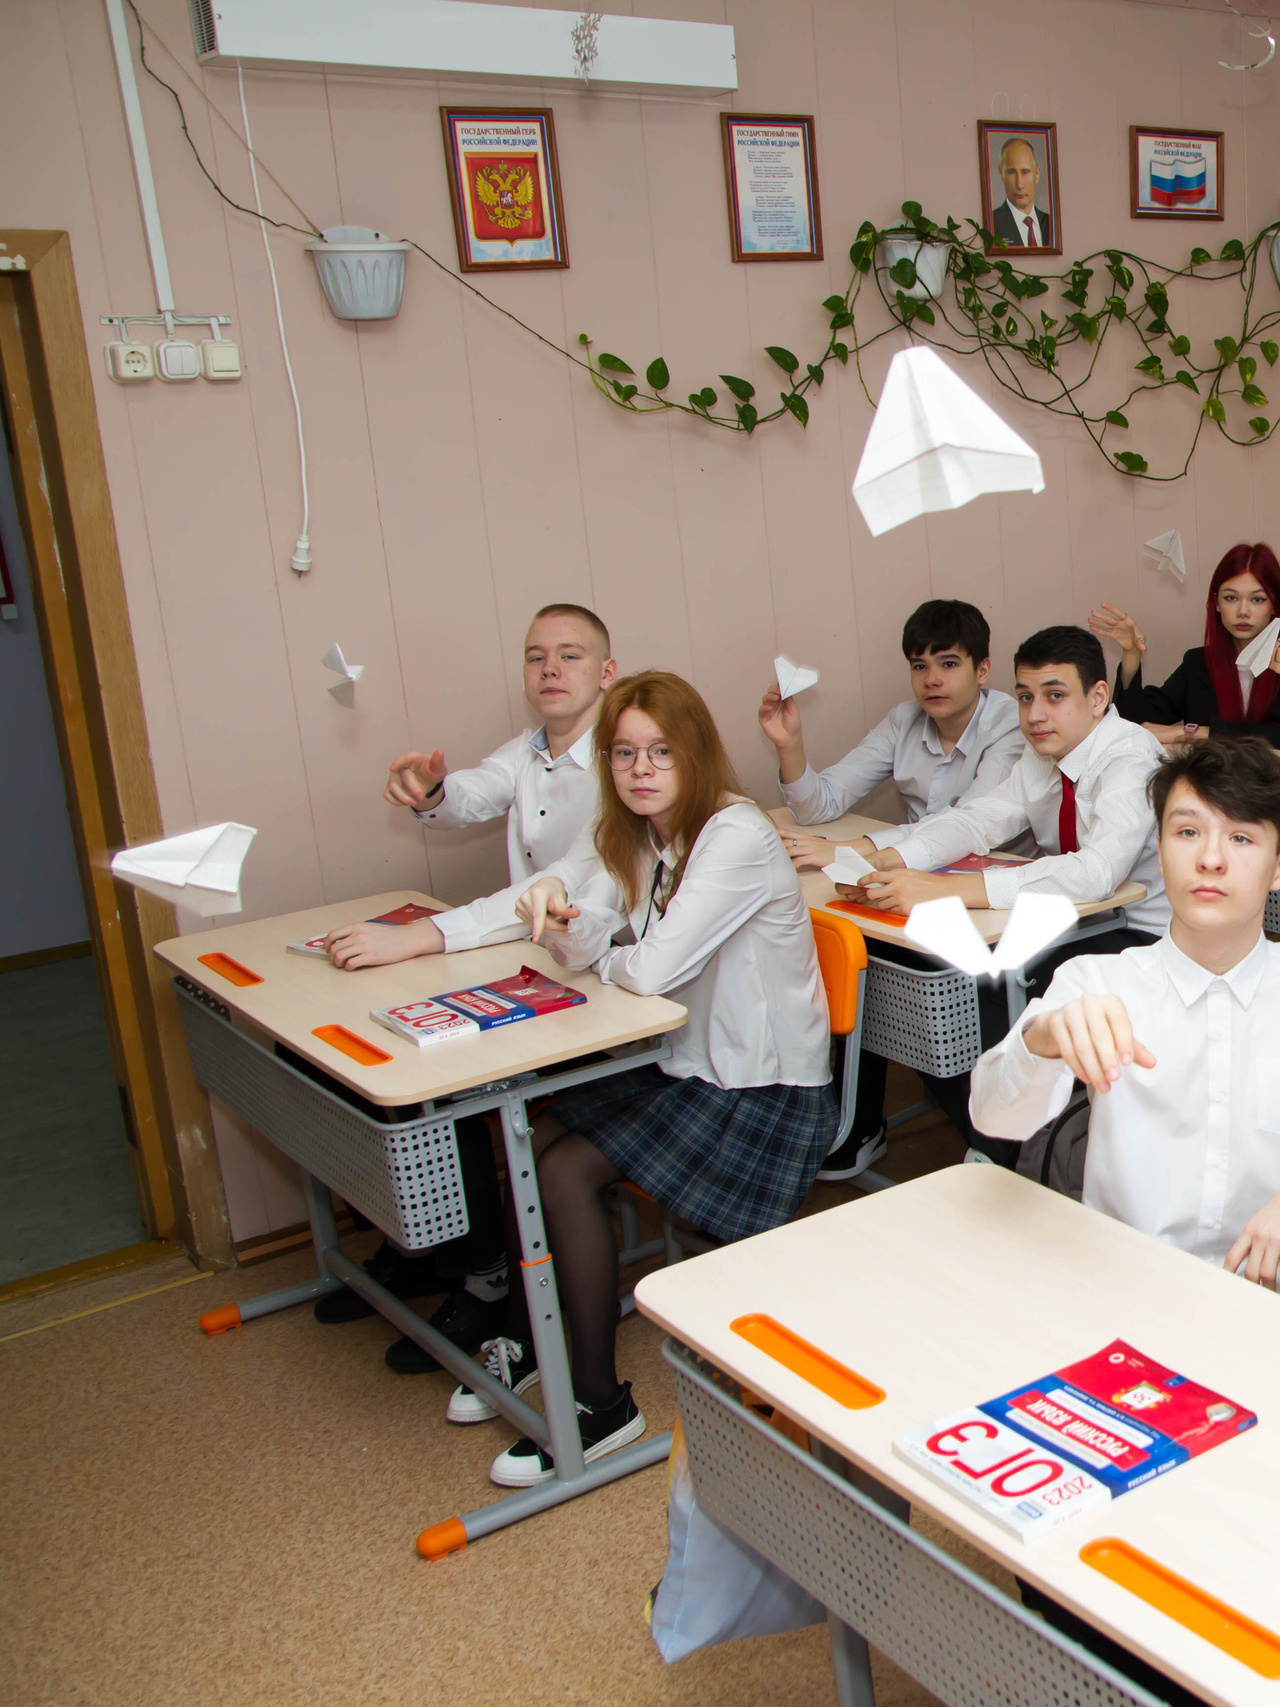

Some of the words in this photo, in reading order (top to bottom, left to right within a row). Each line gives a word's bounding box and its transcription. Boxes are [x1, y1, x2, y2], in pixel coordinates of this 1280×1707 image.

[461, 127, 521, 136] ГОСУДАРСТВЕННЫЙ
[522, 128, 536, 136] ГЕРБ
[462, 137, 501, 146] РОССИЙСКОЙ
[502, 139, 537, 147] ФЕДЕРАЦИИ
[737, 130, 785, 138] ГОСУДАРСТВЕННЫЙ
[737, 138, 770, 147] РОССИЙСКОЙ
[771, 140, 800, 148] ФЕДЕРАЦИИ
[388, 1002, 459, 1028] ОГЭ
[1026, 1399, 1072, 1426] ЯЗЫК
[1061, 1420, 1129, 1458] РУССКИЙ
[926, 1420, 1064, 1497] ОГЭ
[1127, 1467, 1157, 1489] РУССКИЙ
[1042, 1476, 1092, 1505] 2023
